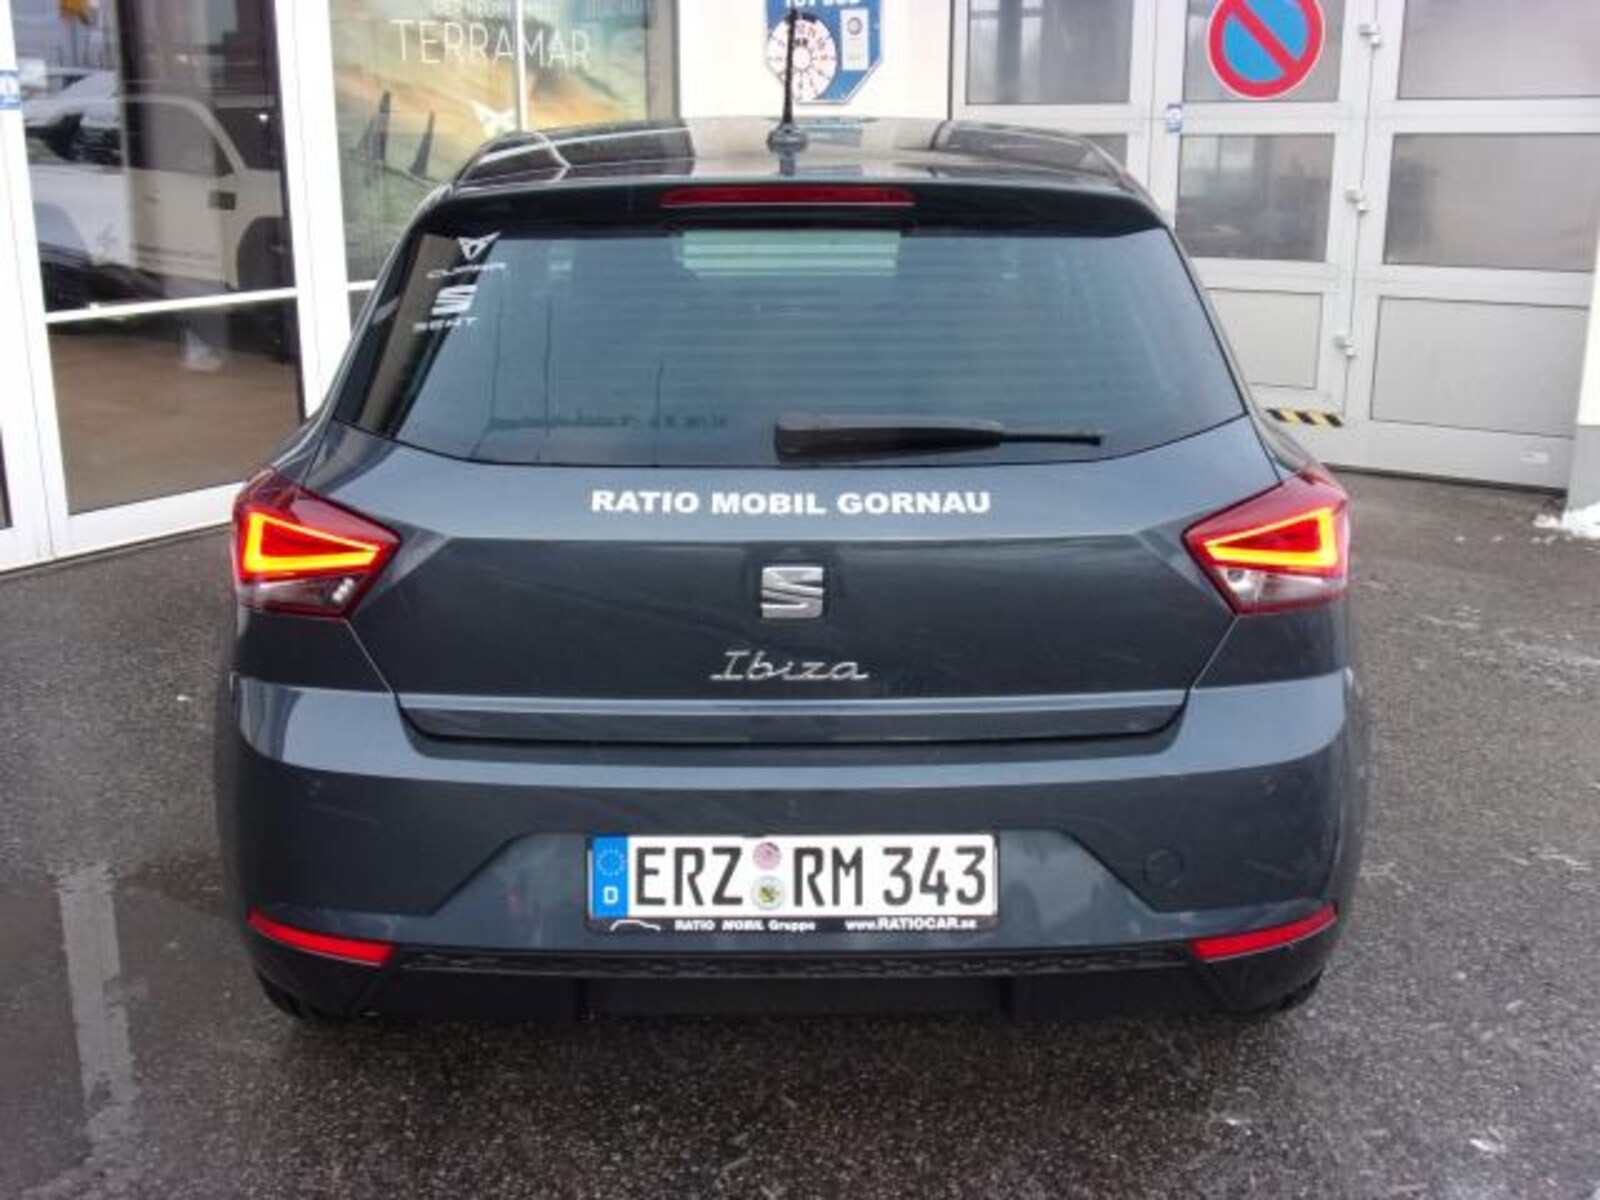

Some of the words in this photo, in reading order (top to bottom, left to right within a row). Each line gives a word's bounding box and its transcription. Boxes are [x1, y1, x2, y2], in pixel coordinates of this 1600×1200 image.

[389, 19, 593, 68] TERRAMAR
[592, 491, 699, 513] RATIO
[712, 493, 826, 514] MOBIL
[838, 493, 989, 513] GORNAU
[711, 651, 868, 680] Ibiza
[637, 847, 742, 905] ERZ
[794, 848, 862, 906] RM
[884, 847, 985, 905] 343
[604, 887, 618, 904] D
[675, 919, 715, 930] RATIO
